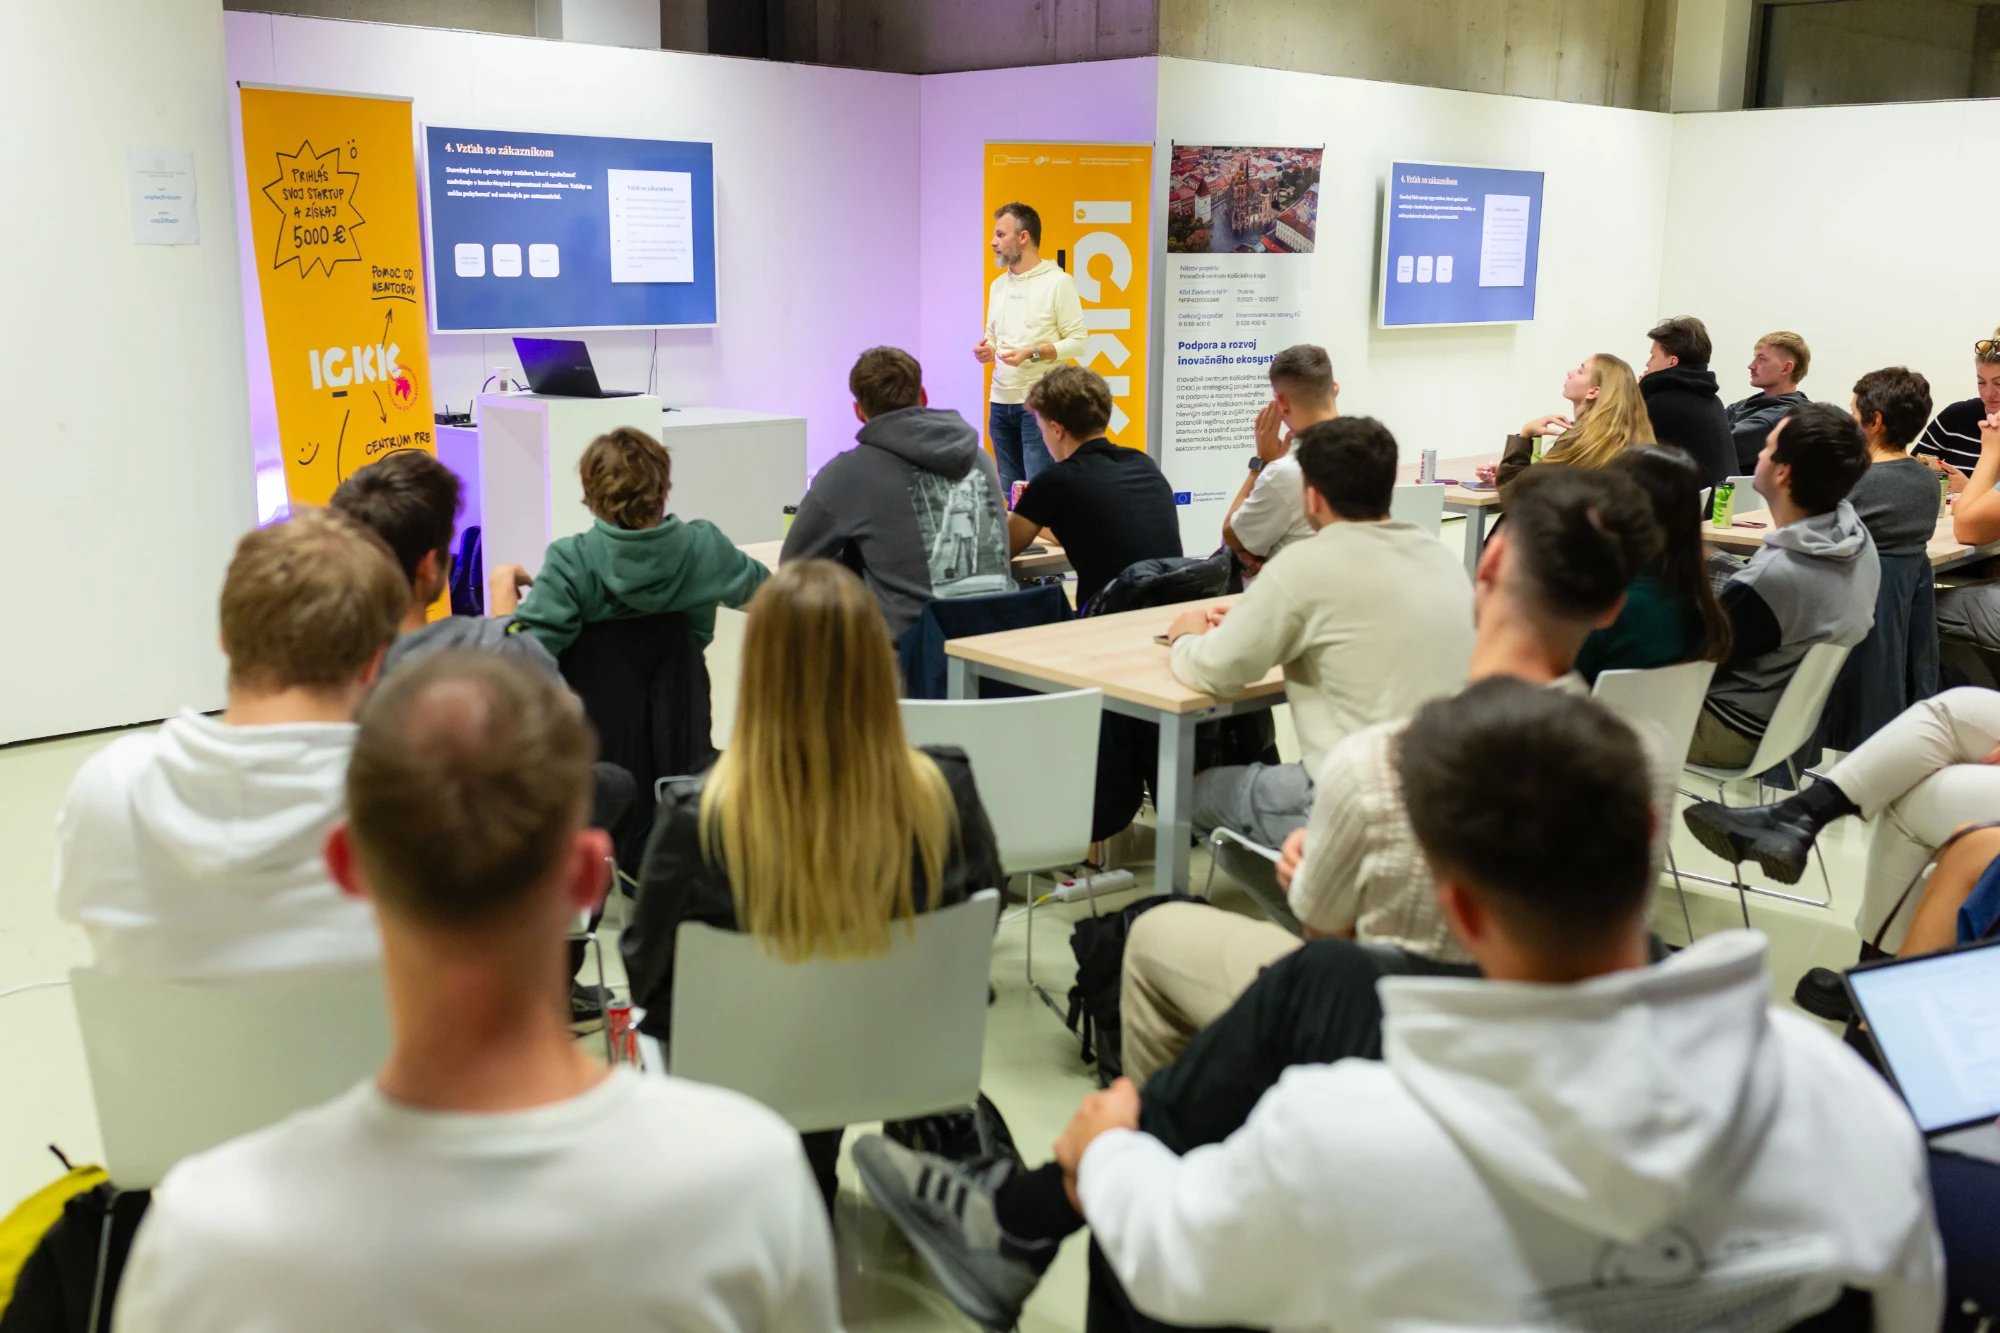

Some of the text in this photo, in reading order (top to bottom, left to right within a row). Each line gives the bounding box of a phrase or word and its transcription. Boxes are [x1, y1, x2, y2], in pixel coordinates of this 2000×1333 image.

[445, 143, 554, 158] 4. Vzťah so zákazníkom
[291, 164, 329, 183] PRIHLÁS
[282, 187, 345, 201] SVOJ STARTUP
[294, 201, 337, 219] A ZÍSKAJ
[293, 224, 347, 249] 5000 €
[371, 265, 414, 280] POMOC OD
[372, 282, 416, 296] MENTOROV
[1178, 339, 1257, 352] Podpora a rozvoj
[308, 342, 402, 391] ICKK
[1177, 354, 1234, 366] inovačného
[1185, 393, 1210, 401] podporu
[1215, 392, 1233, 400] rozvoj
[1217, 400, 1244, 408] Košickom
[365, 431, 431, 456] CENTRUM PRE
